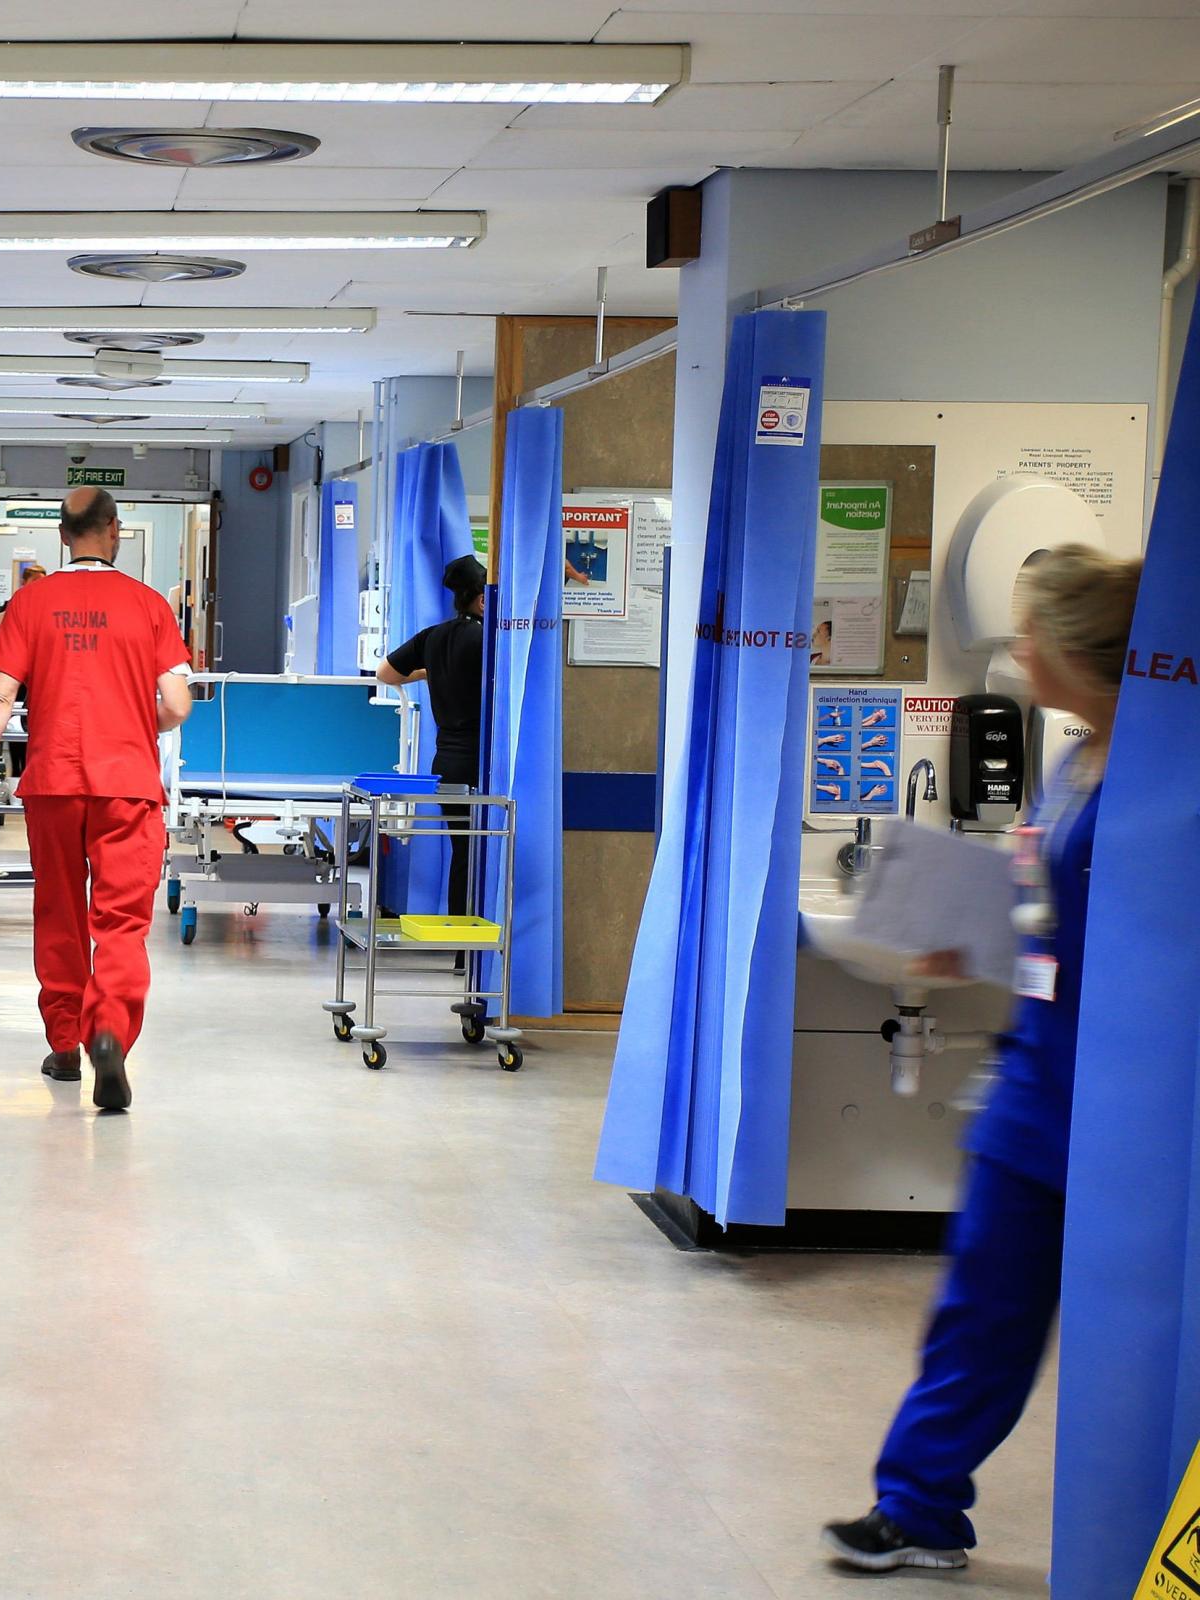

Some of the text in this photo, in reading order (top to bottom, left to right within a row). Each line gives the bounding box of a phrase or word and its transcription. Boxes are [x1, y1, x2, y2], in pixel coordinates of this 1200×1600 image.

[85, 471, 123, 482] FIRE EXIT
[52, 610, 108, 629] TRAUMA
[63, 633, 98, 652] TEAM
[742, 630, 780, 648] NOT
[861, 697, 898, 705] technique
[909, 714, 934, 723] VERY
[917, 724, 949, 732] WATER
